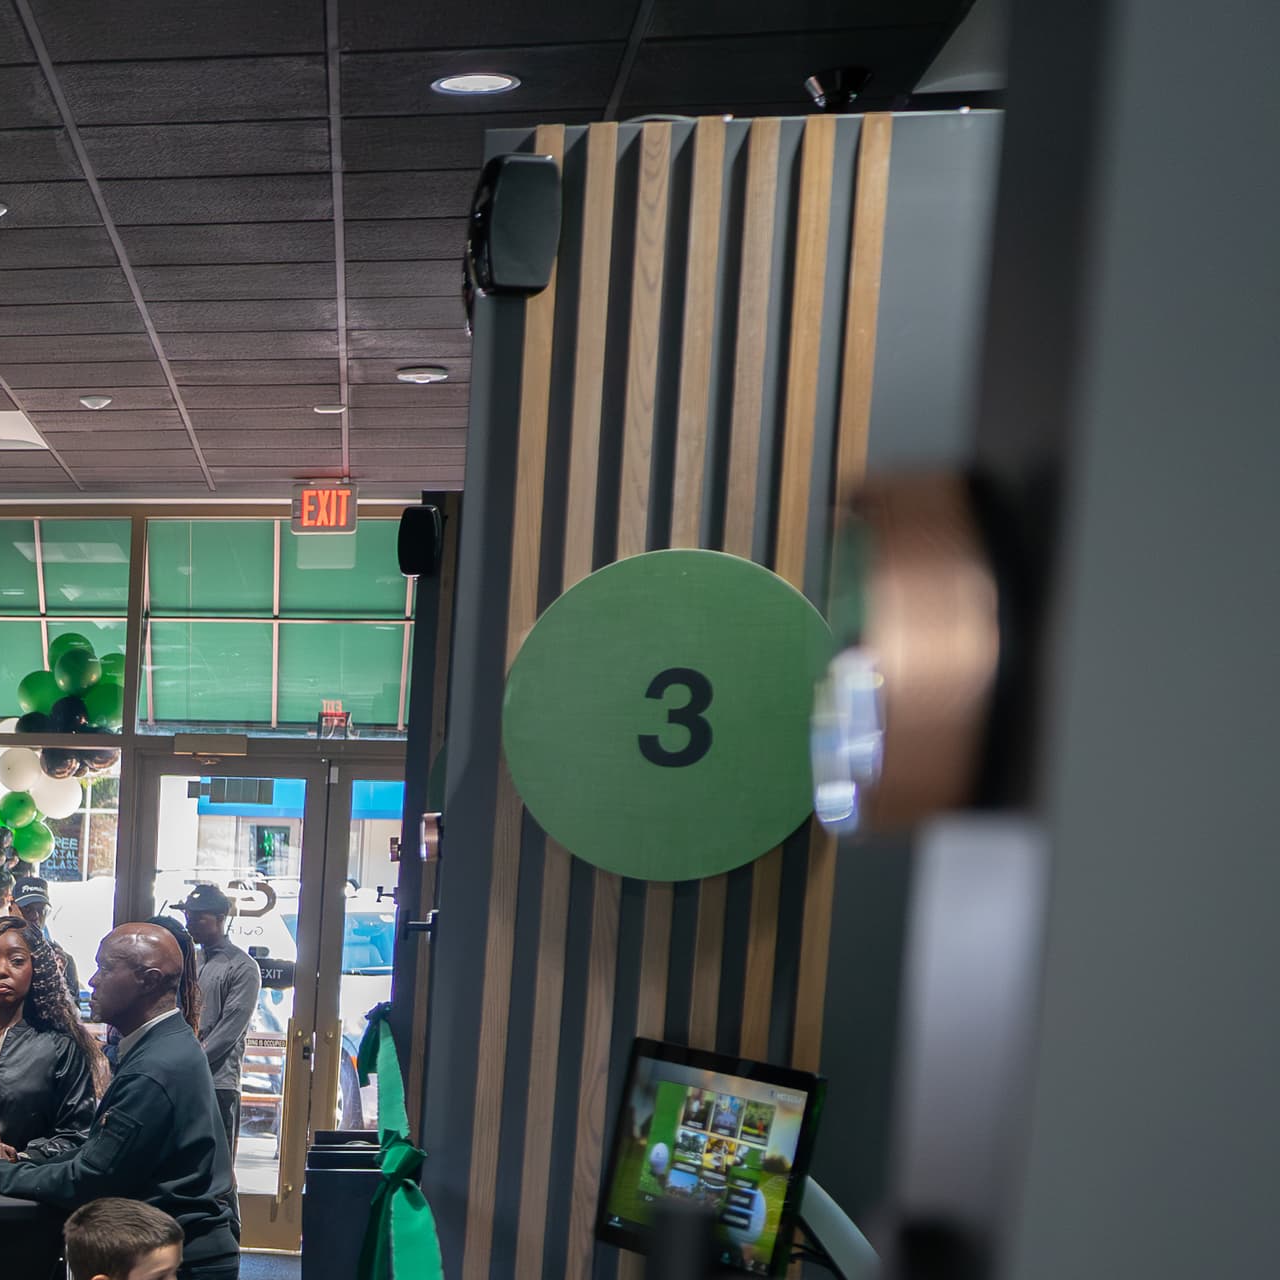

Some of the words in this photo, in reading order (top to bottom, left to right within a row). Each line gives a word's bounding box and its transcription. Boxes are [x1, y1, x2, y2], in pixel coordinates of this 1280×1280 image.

[301, 489, 351, 527] EXIT
[638, 667, 713, 768] 3
[54, 836, 78, 850] REE
[52, 849, 78, 859] RIAL
[260, 968, 283, 979] EXIT
